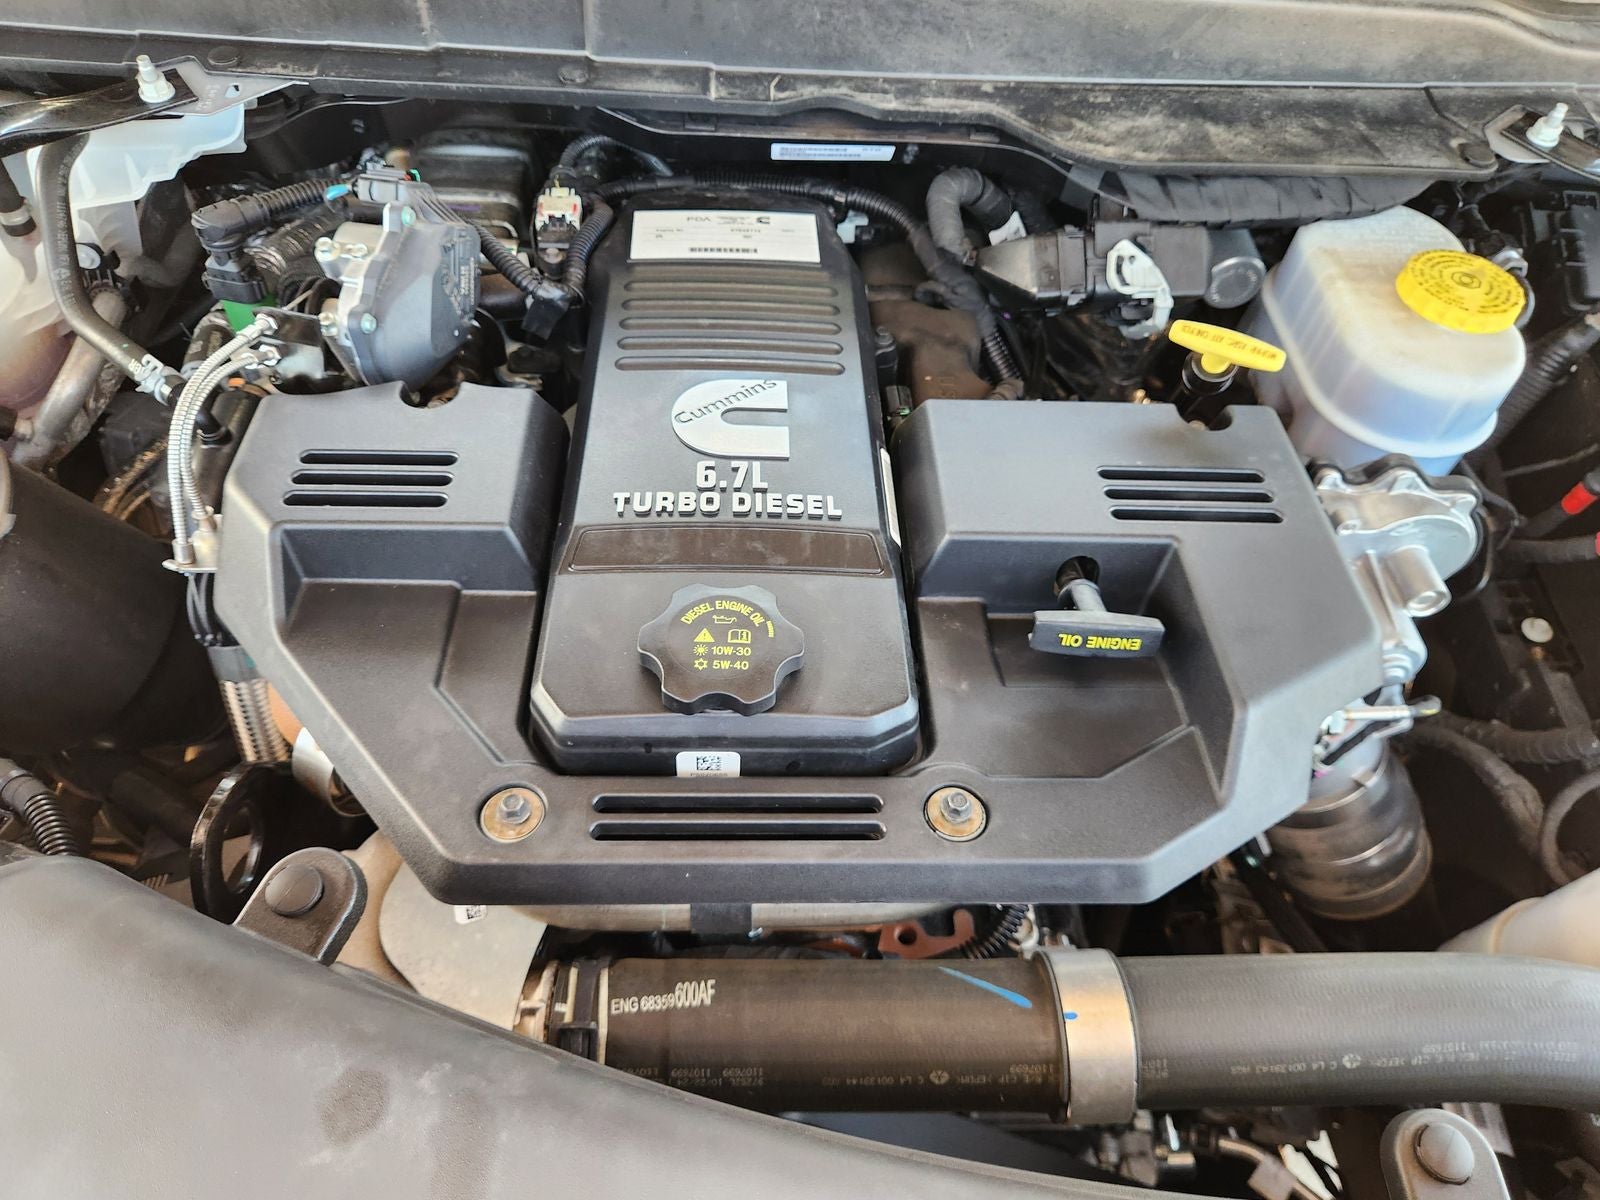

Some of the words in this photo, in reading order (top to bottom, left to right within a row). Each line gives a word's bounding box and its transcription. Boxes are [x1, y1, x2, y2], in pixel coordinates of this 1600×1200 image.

[674, 379, 777, 424] Cummins
[696, 461, 769, 491] 6.7L
[613, 491, 721, 516] TURBO
[731, 491, 843, 519] DIESEL
[680, 602, 714, 625] DIESEL
[715, 600, 754, 616] ENGINE
[749, 612, 765, 627] OIL
[1058, 633, 1083, 648] OIL
[1085, 636, 1142, 651] ENGINE
[711, 646, 752, 656] 10W-30
[713, 660, 749, 670] 5W-40
[611, 996, 639, 1015] ENG
